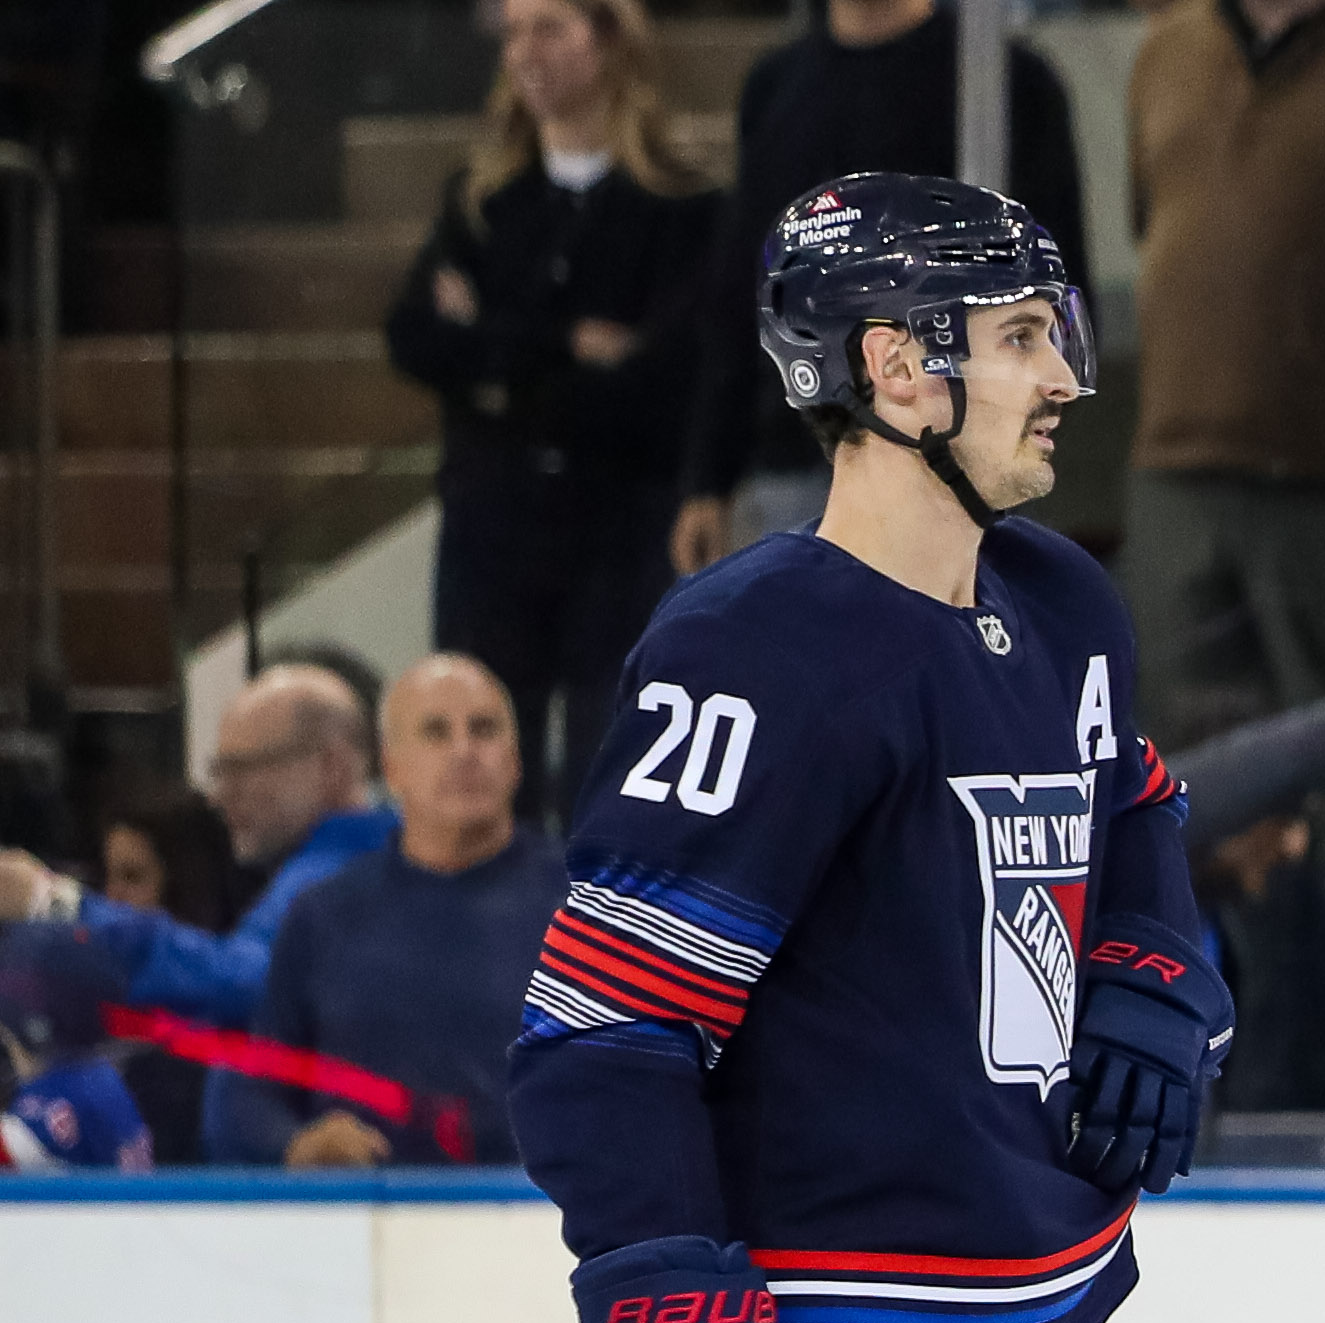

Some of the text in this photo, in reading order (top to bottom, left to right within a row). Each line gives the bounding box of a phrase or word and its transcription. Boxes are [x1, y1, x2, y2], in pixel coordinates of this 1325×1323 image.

[788, 206, 862, 235] Benjamin
[799, 224, 851, 247] Moore
[1075, 654, 1118, 765] A
[619, 681, 757, 816] 20
[991, 814, 1090, 866] NEW YO
